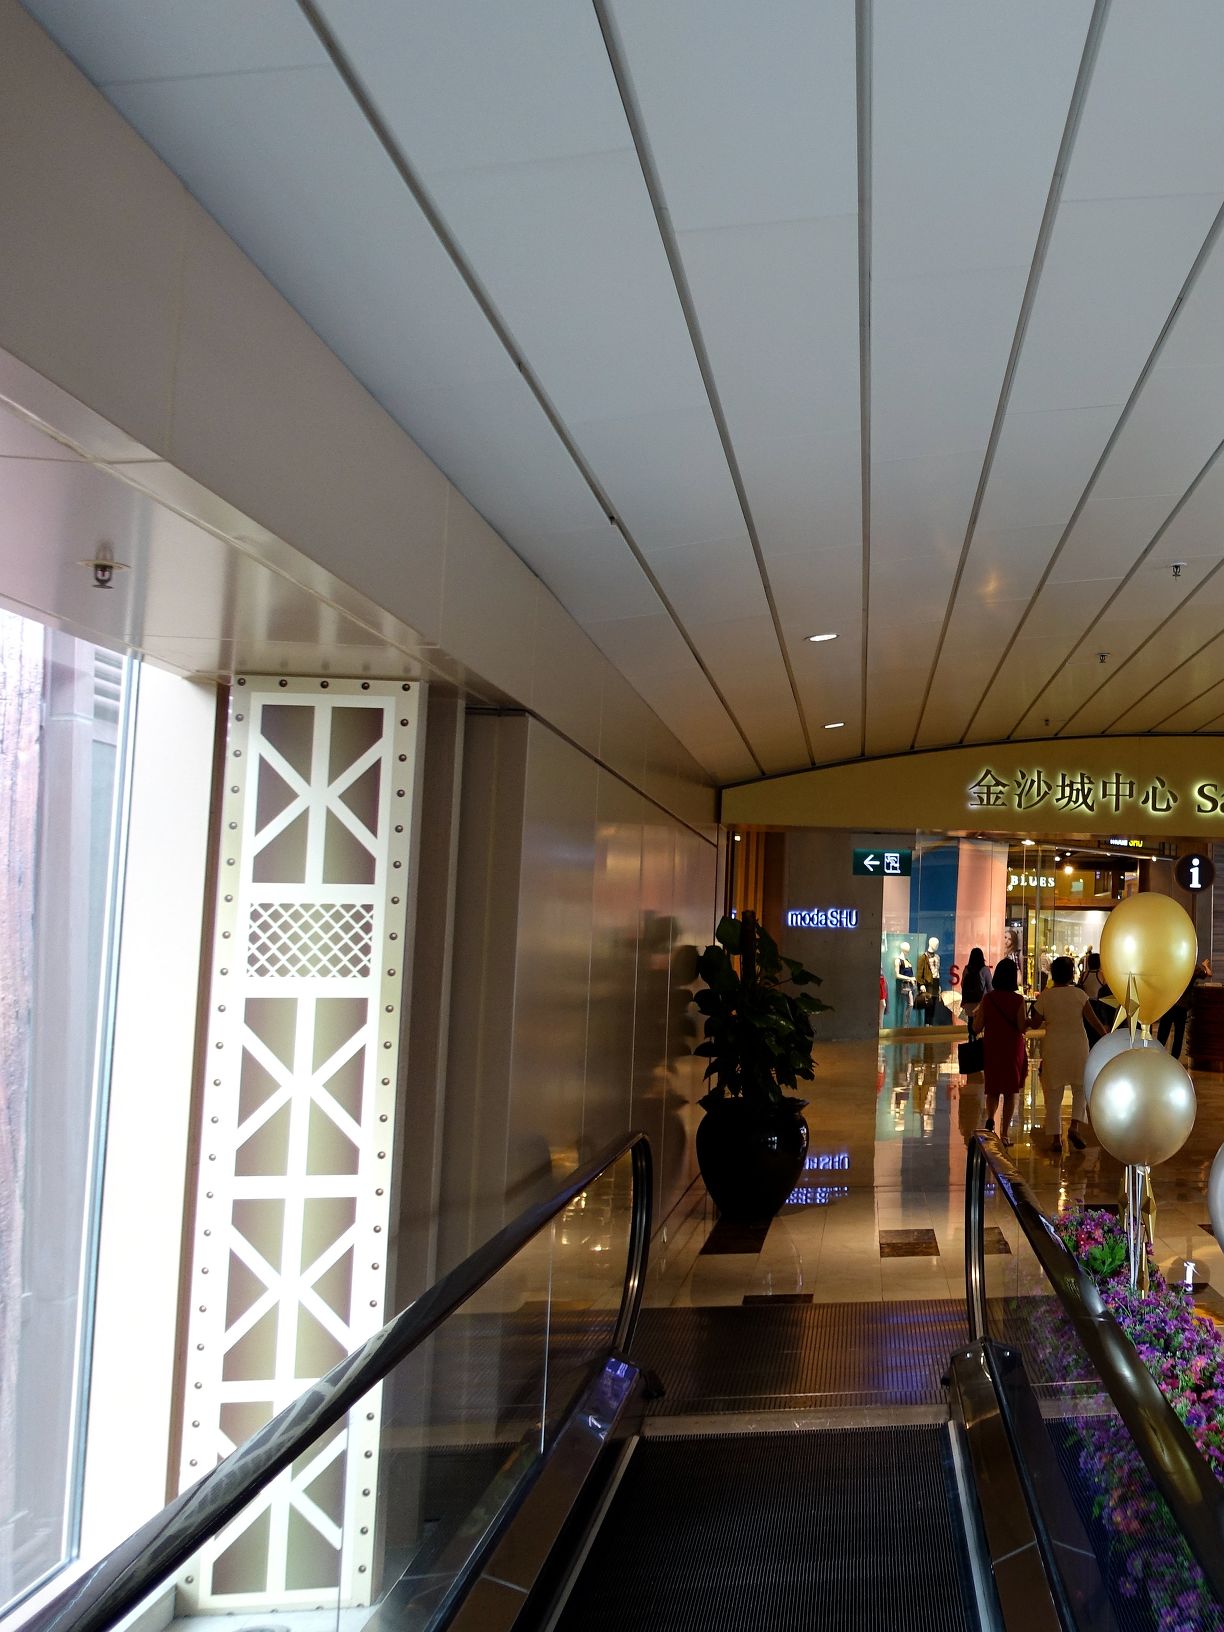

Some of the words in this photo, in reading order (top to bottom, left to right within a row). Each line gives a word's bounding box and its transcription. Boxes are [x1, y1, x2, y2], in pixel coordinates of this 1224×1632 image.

[969, 768, 1179, 813] 金沙城中心
[1010, 875, 1056, 887] BLUES
